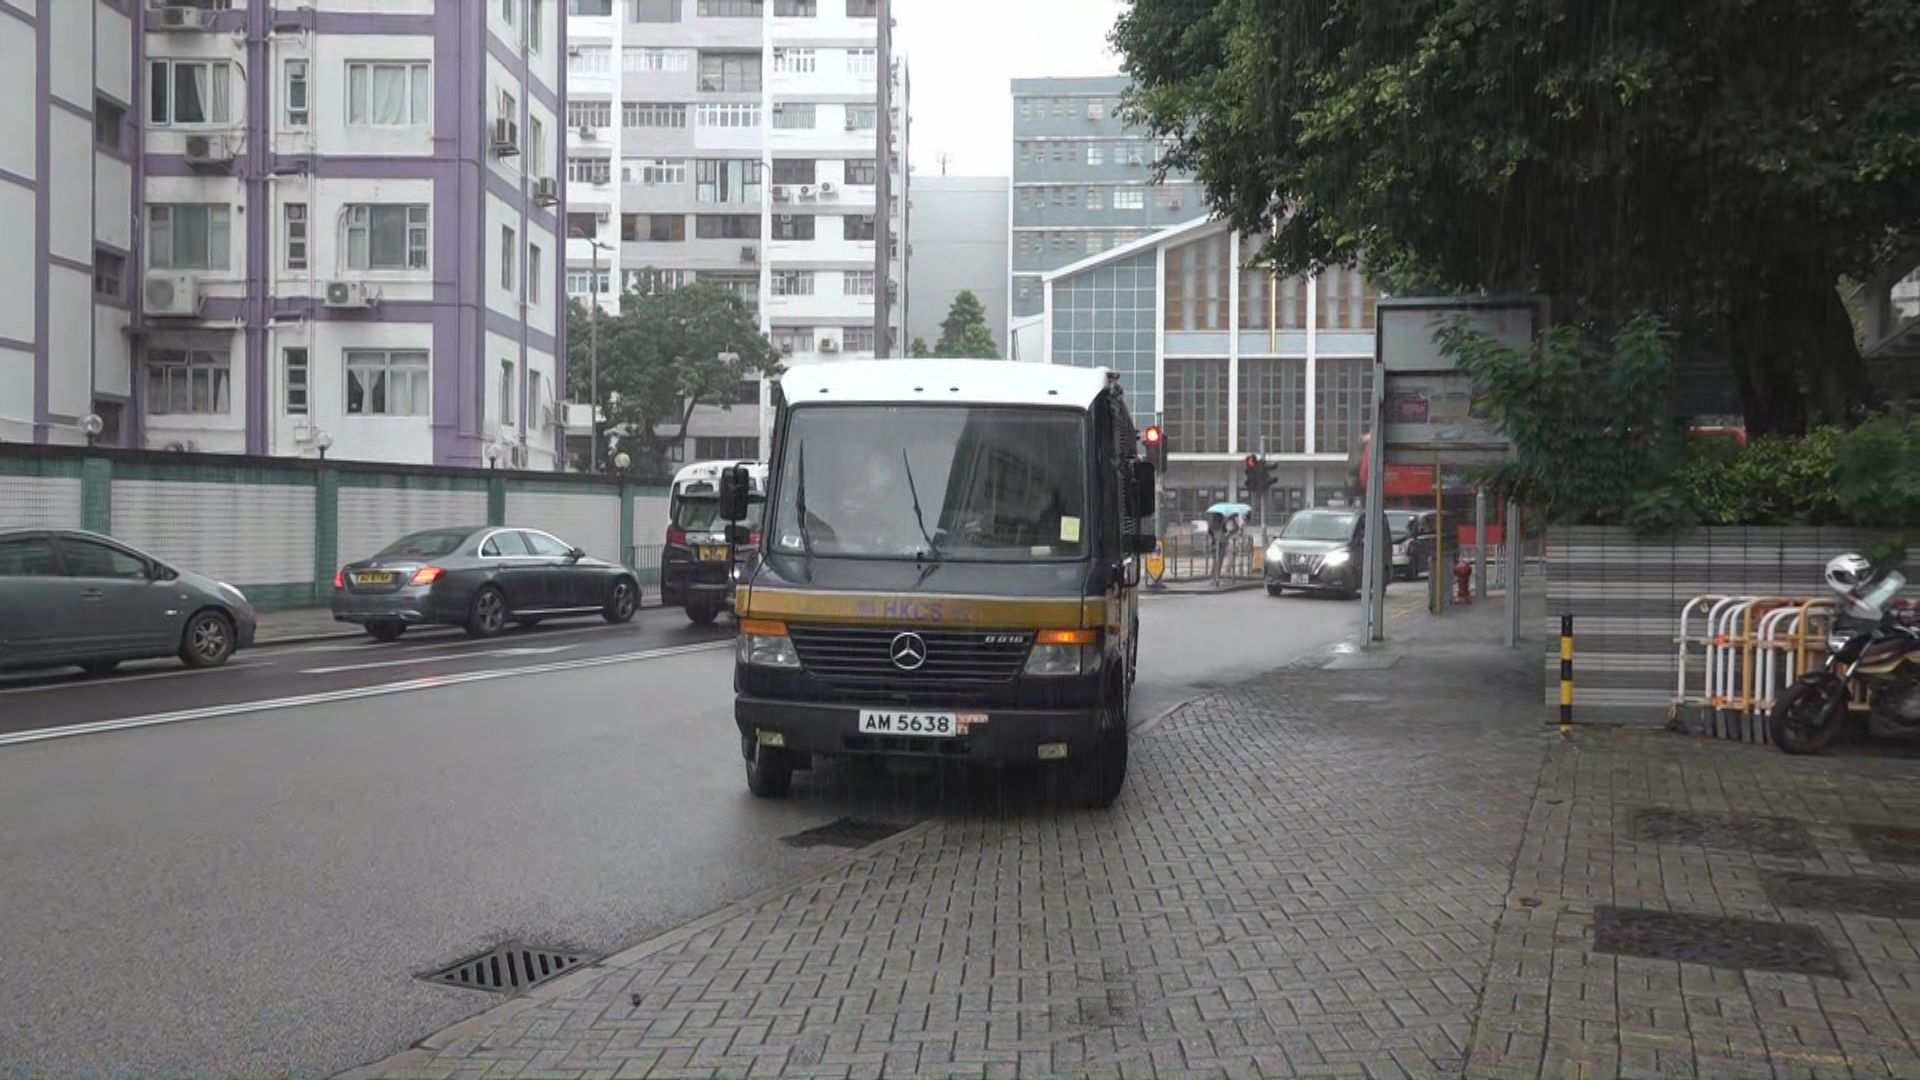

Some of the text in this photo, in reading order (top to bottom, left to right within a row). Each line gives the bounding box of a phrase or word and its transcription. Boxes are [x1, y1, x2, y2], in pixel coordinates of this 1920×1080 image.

[884, 602, 944, 621] HKCS
[865, 714, 891, 730] AM
[897, 715, 949, 732] 5638
